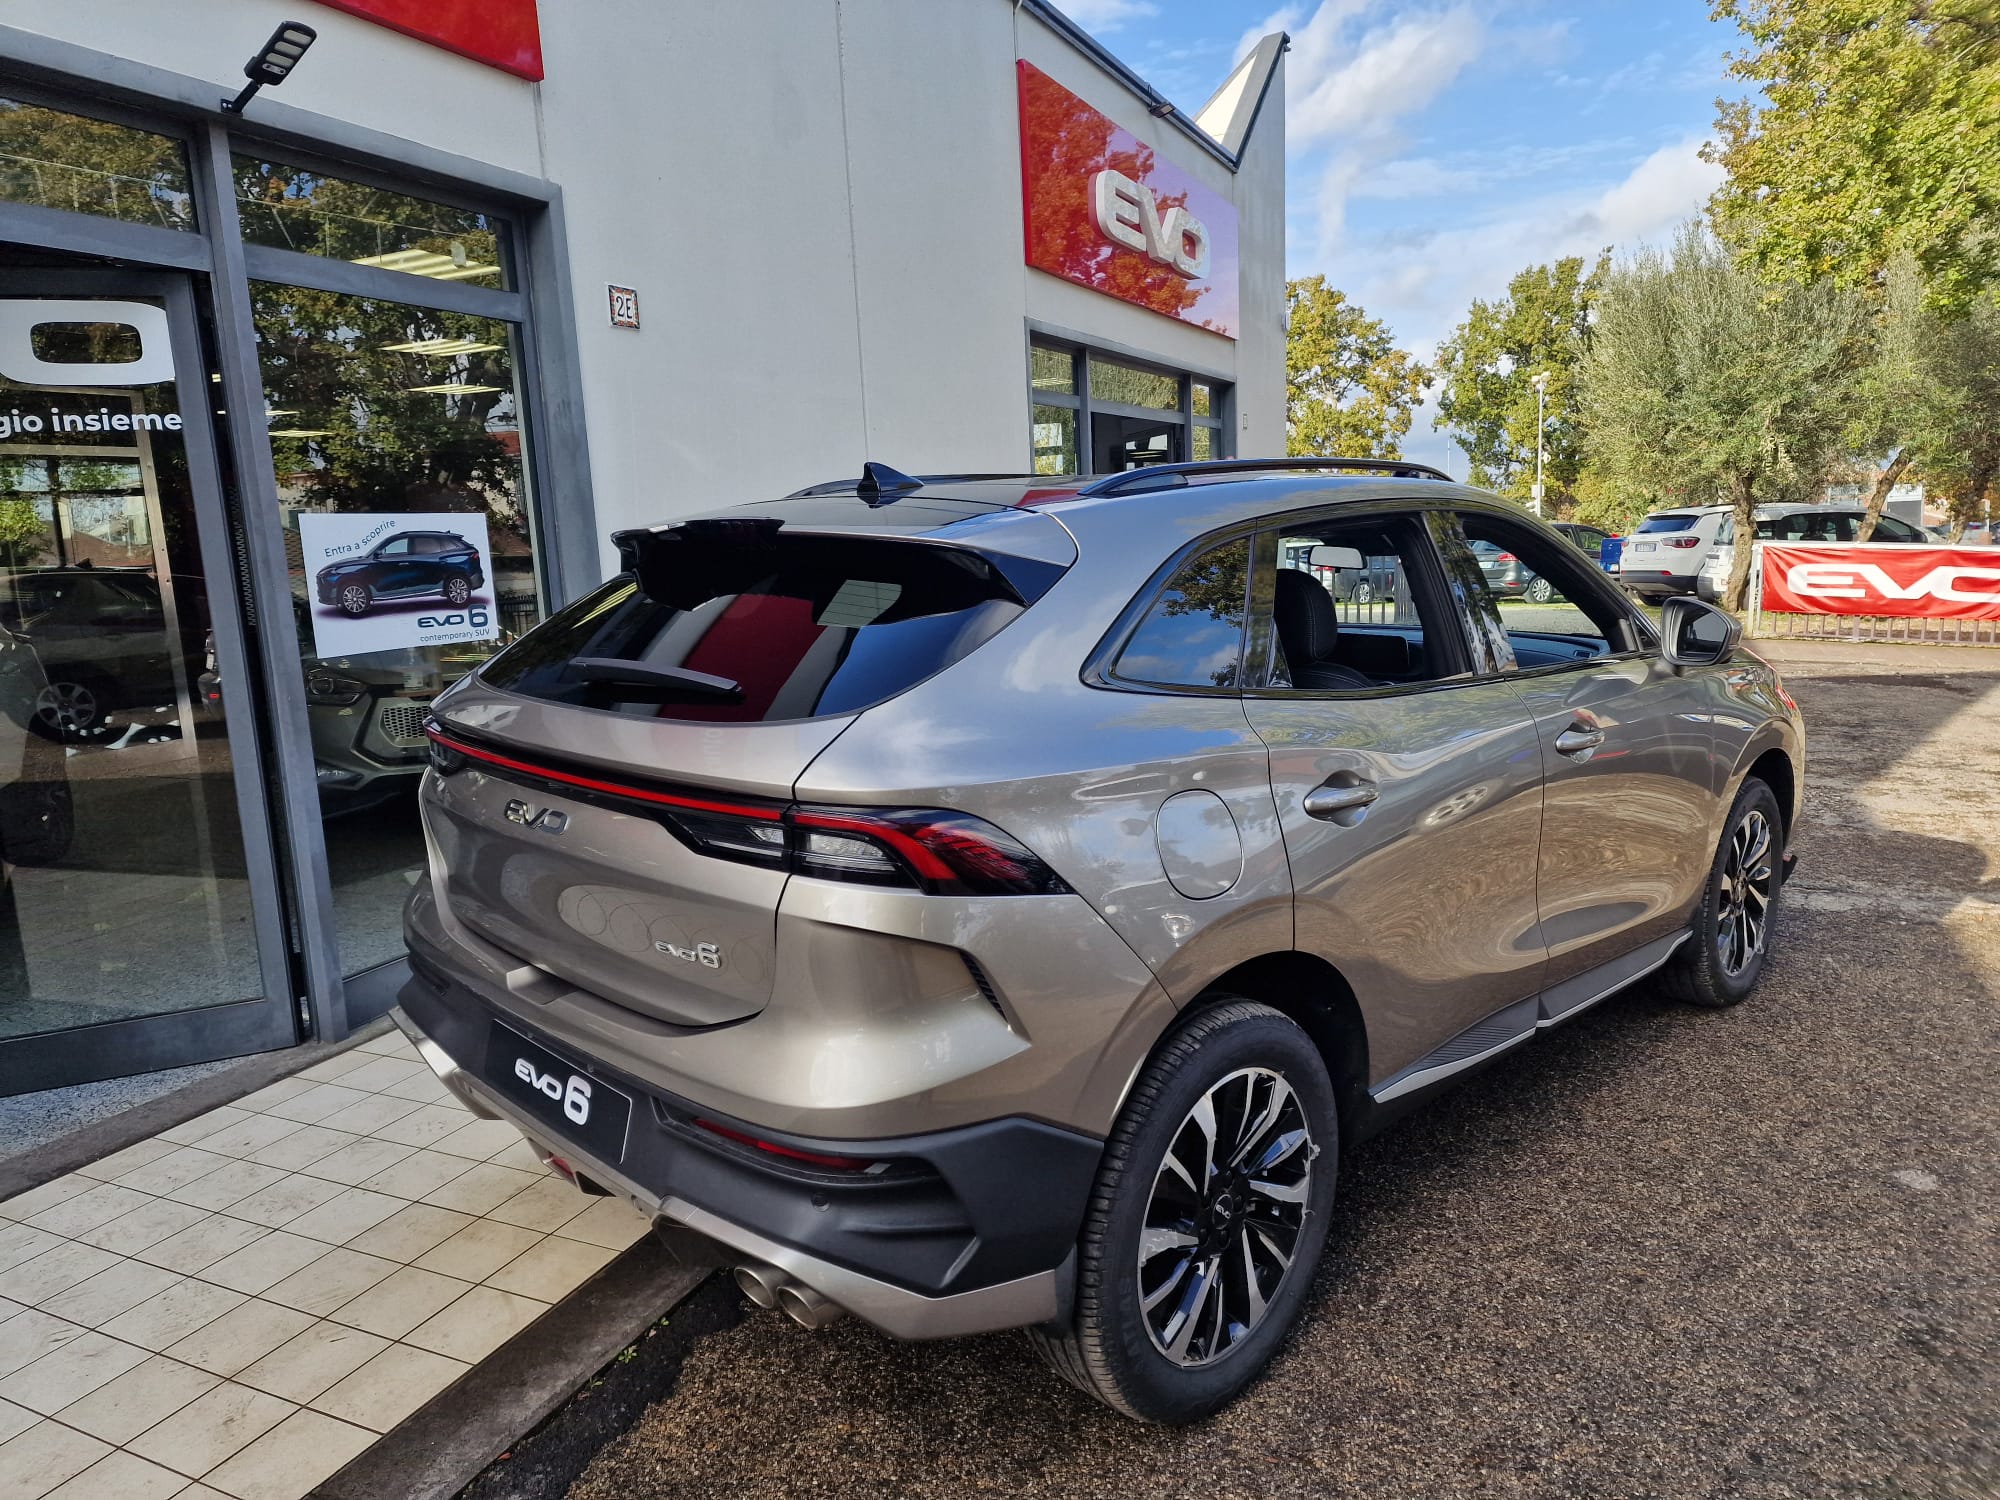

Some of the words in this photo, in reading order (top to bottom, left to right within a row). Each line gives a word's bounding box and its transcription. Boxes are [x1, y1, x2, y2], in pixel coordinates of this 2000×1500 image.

[1096, 169, 1211, 280] EVO
[616, 295, 633, 319] 2E
[51, 407, 183, 432] insieme
[324, 544, 352, 558] Entra
[354, 542, 360, 550] a
[361, 520, 396, 546] scoprire
[420, 630, 473, 642] contemporary
[475, 628, 490, 637] SUV
[504, 798, 570, 836] EVO
